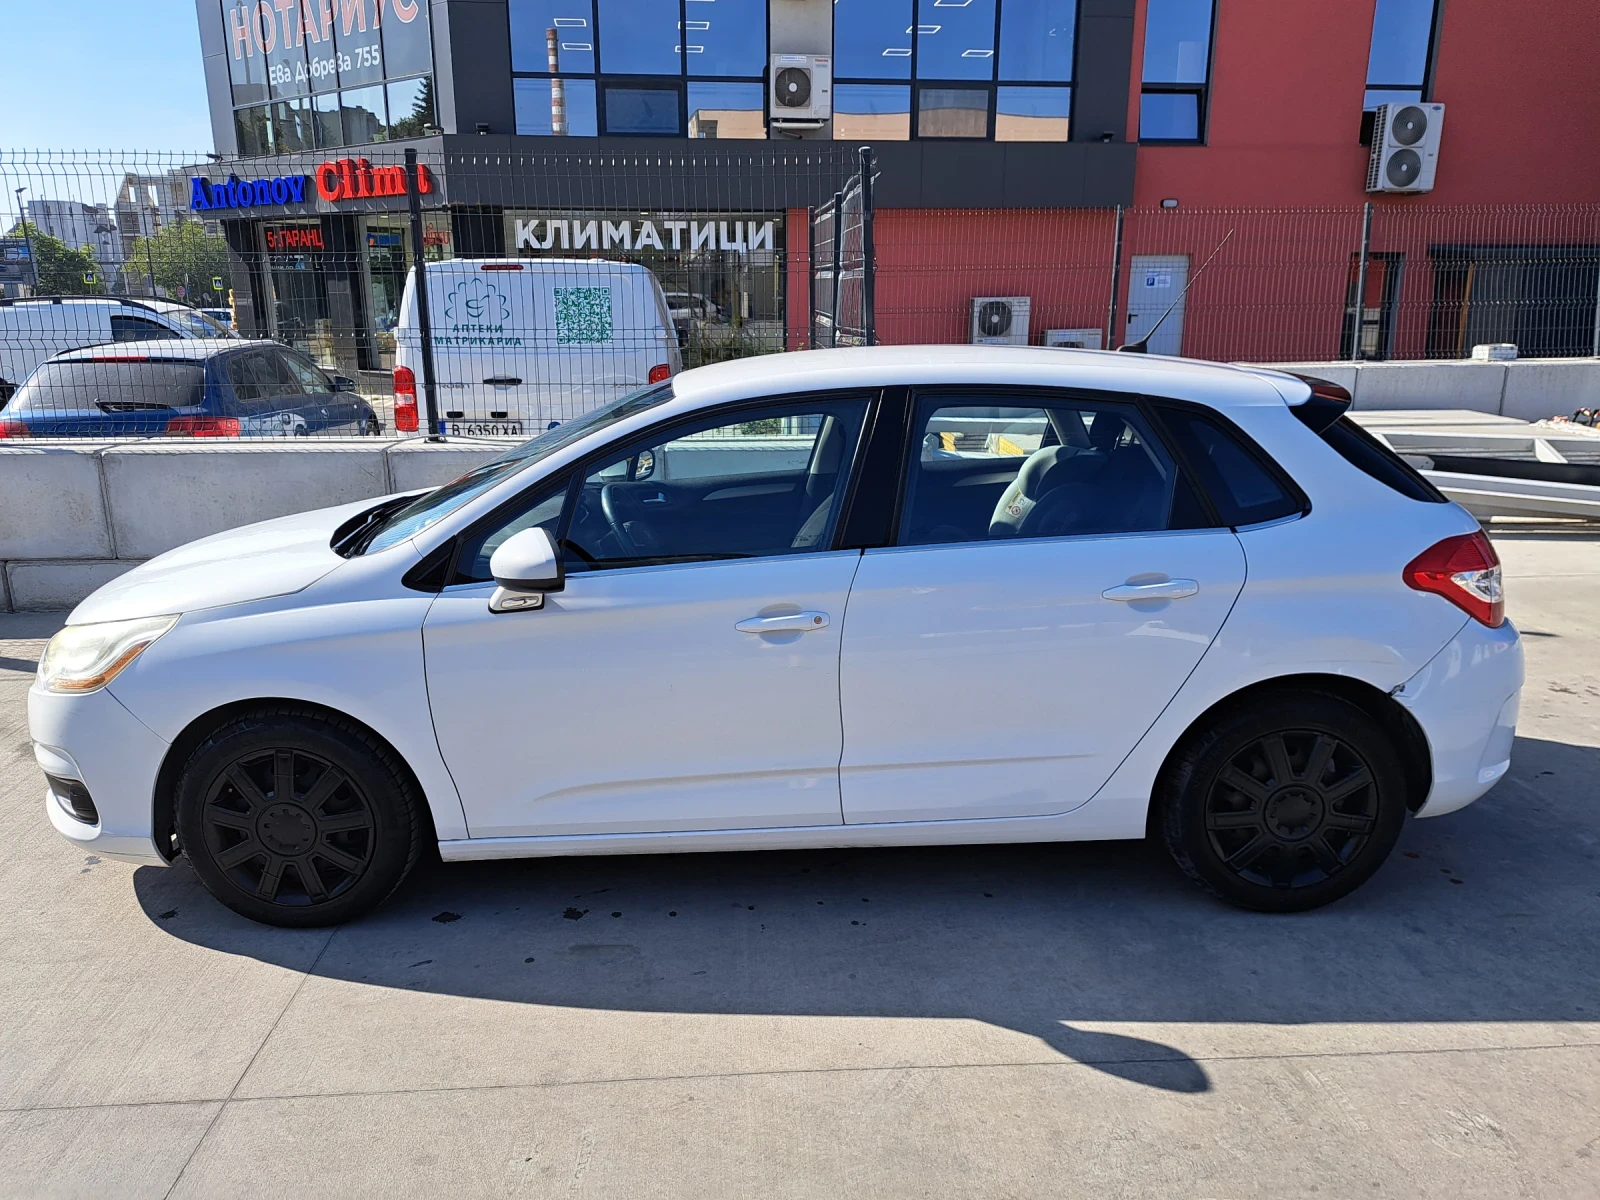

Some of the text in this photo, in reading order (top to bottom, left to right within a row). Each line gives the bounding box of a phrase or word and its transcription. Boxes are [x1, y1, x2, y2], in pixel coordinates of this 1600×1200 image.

[269, 44, 380, 86] Ева Добрева 755
[190, 172, 305, 210] Antonov
[515, 218, 774, 252] КЛИМАТИЦИ
[452, 324, 504, 334] АПТЕКИ
[467, 424, 498, 435] 6350
